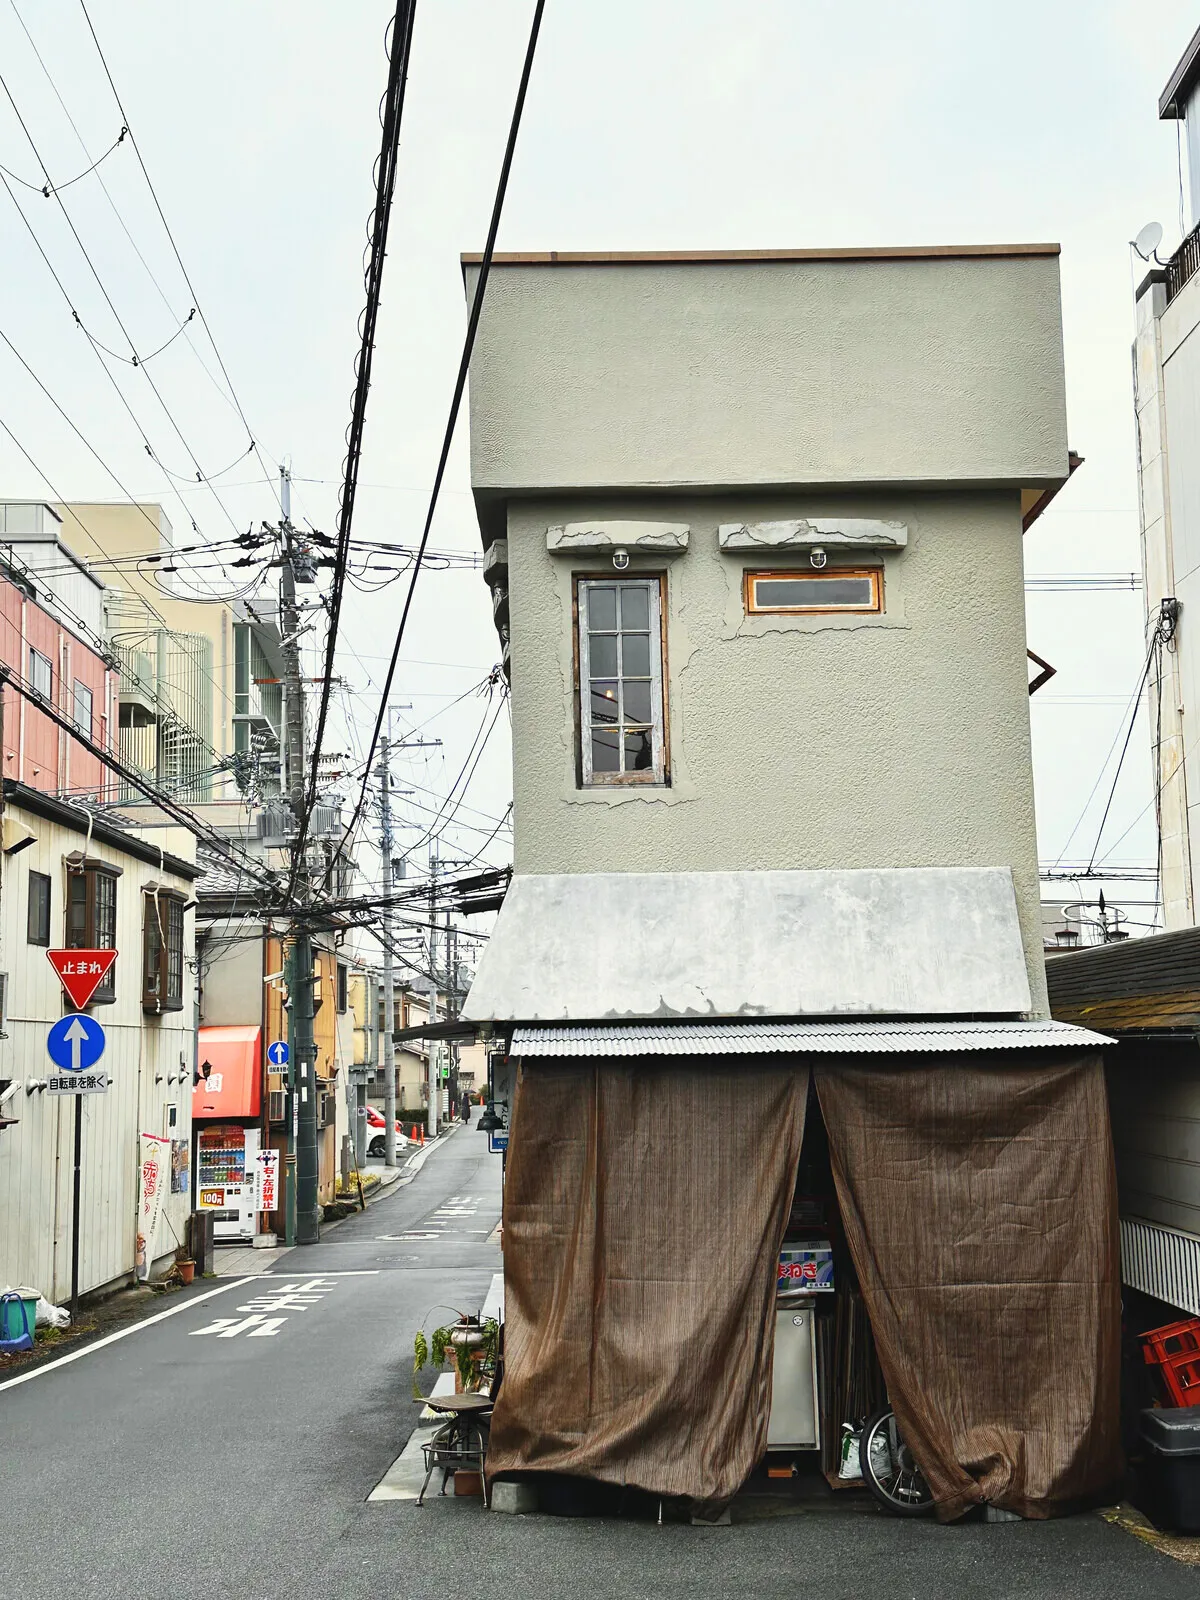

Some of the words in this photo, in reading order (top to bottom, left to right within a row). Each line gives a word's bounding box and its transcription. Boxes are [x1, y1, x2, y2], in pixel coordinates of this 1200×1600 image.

[61, 961, 103, 975] 止まれ
[49, 1075, 105, 1090] 自転車を除く
[188, 1278, 339, 1339] 止まれ
